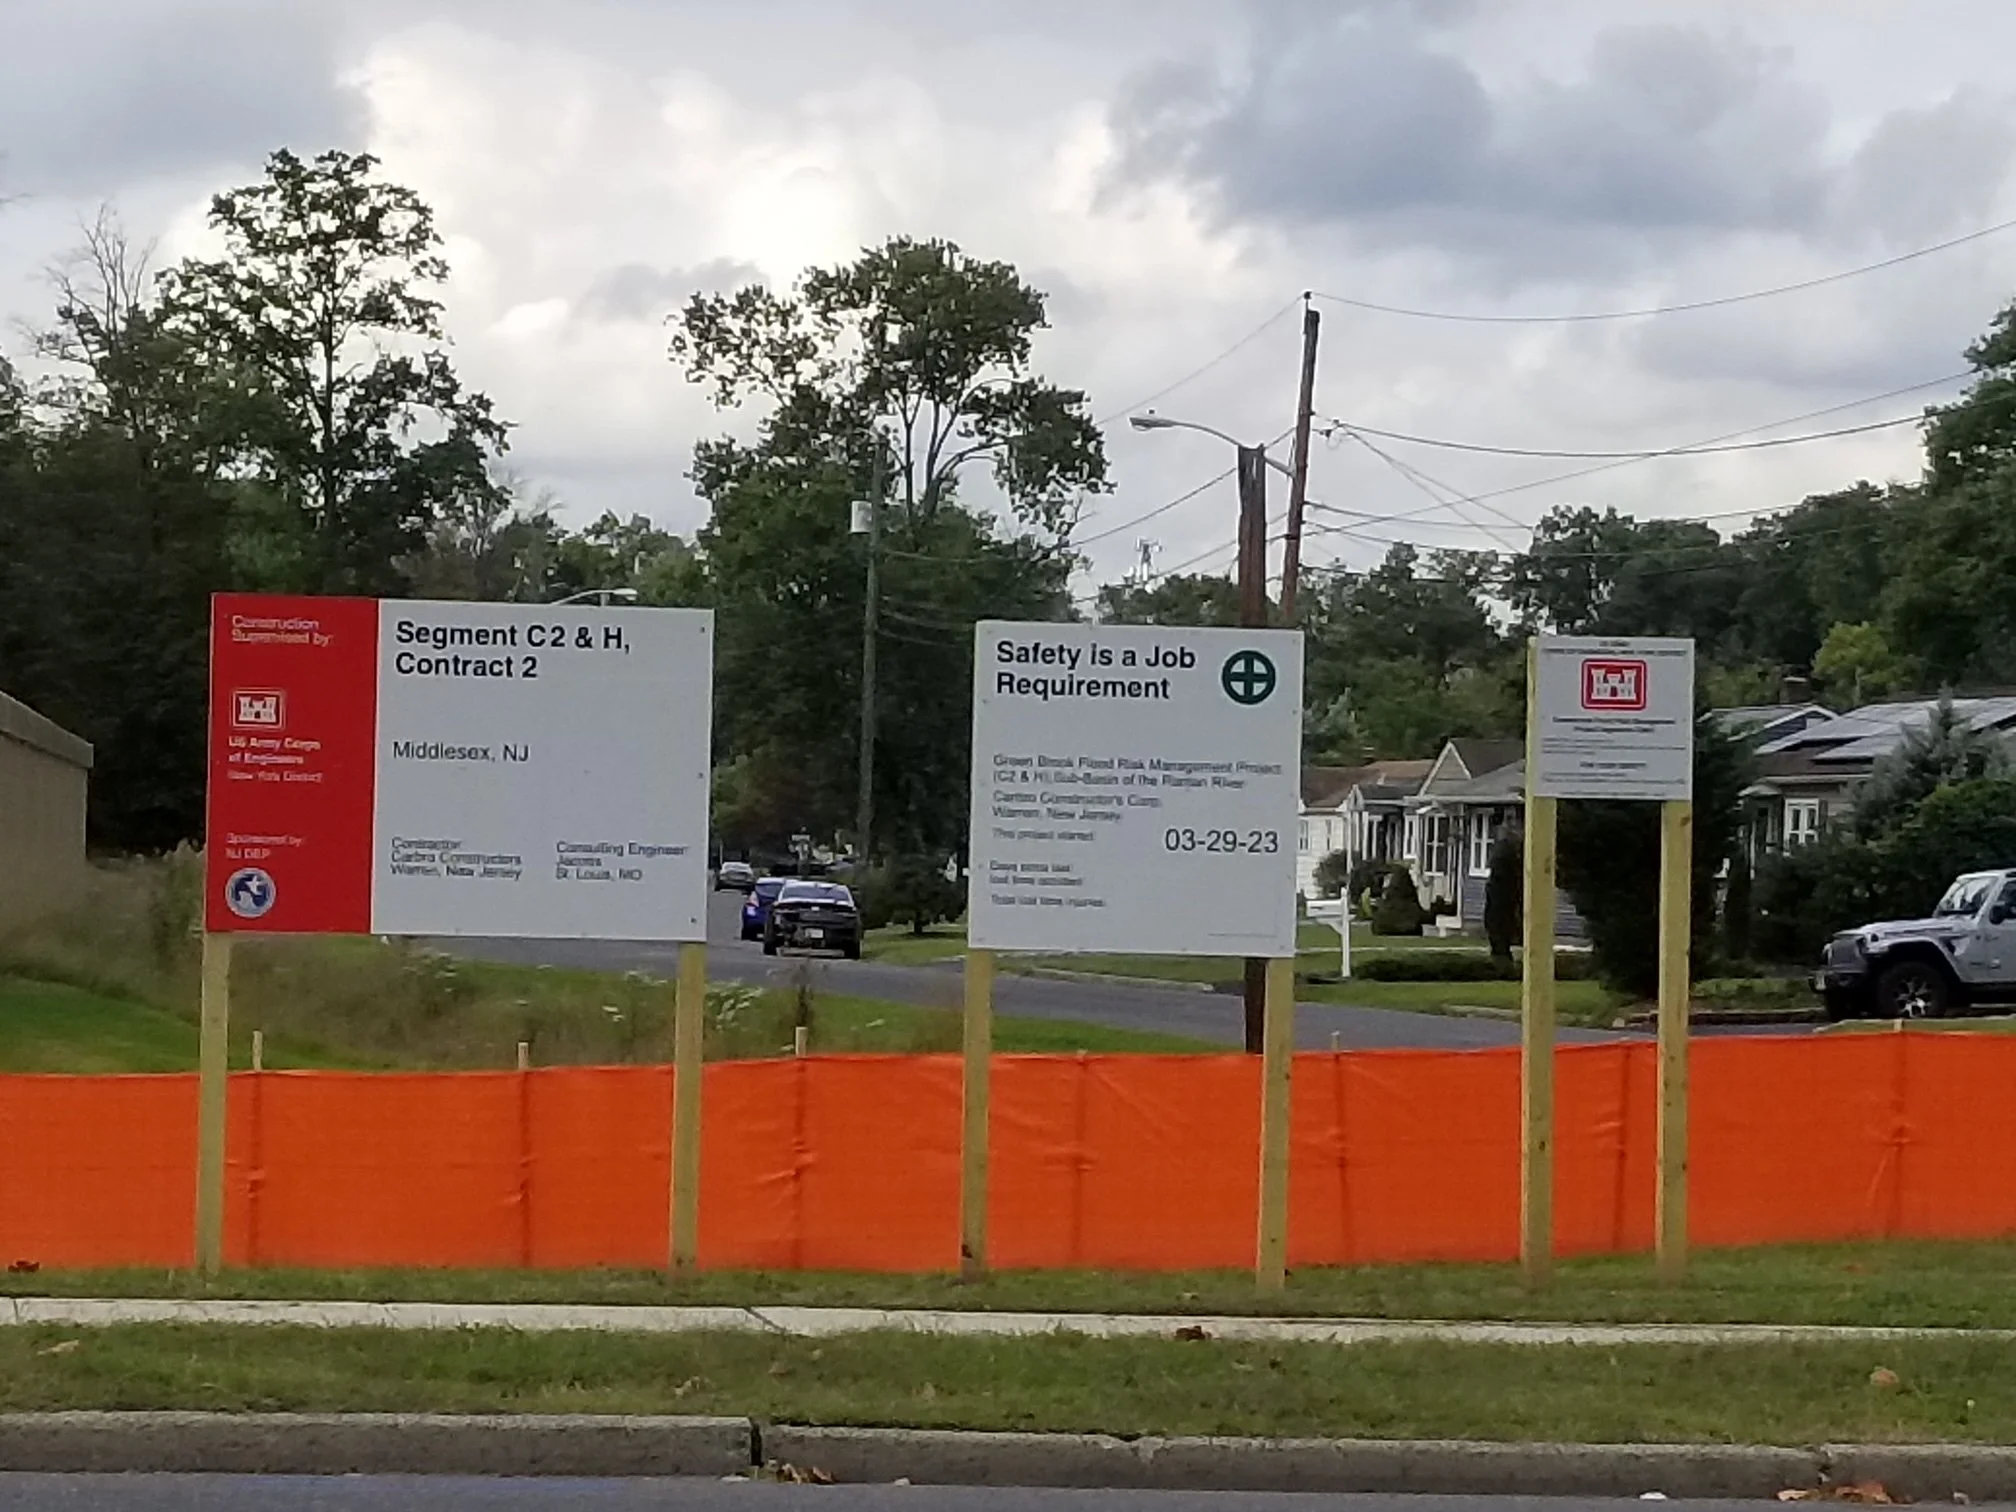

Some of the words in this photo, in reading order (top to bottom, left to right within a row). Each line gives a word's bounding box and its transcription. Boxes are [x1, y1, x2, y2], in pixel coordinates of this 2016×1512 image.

[396, 621, 517, 650] Segment
[574, 627, 593, 649] &
[603, 627, 630, 653] H,
[395, 652, 513, 678] Contract
[522, 657, 538, 678] 2
[997, 641, 1081, 670] Safety
[1090, 643, 1113, 666] is
[1122, 649, 1136, 666] a
[1145, 646, 1196, 669] Job
[997, 672, 1170, 700] Requirement
[393, 741, 496, 763] Middlesex,
[503, 745, 530, 763] NJ
[556, 841, 625, 857] Consulting
[1164, 827, 1279, 854] 03-29-23
